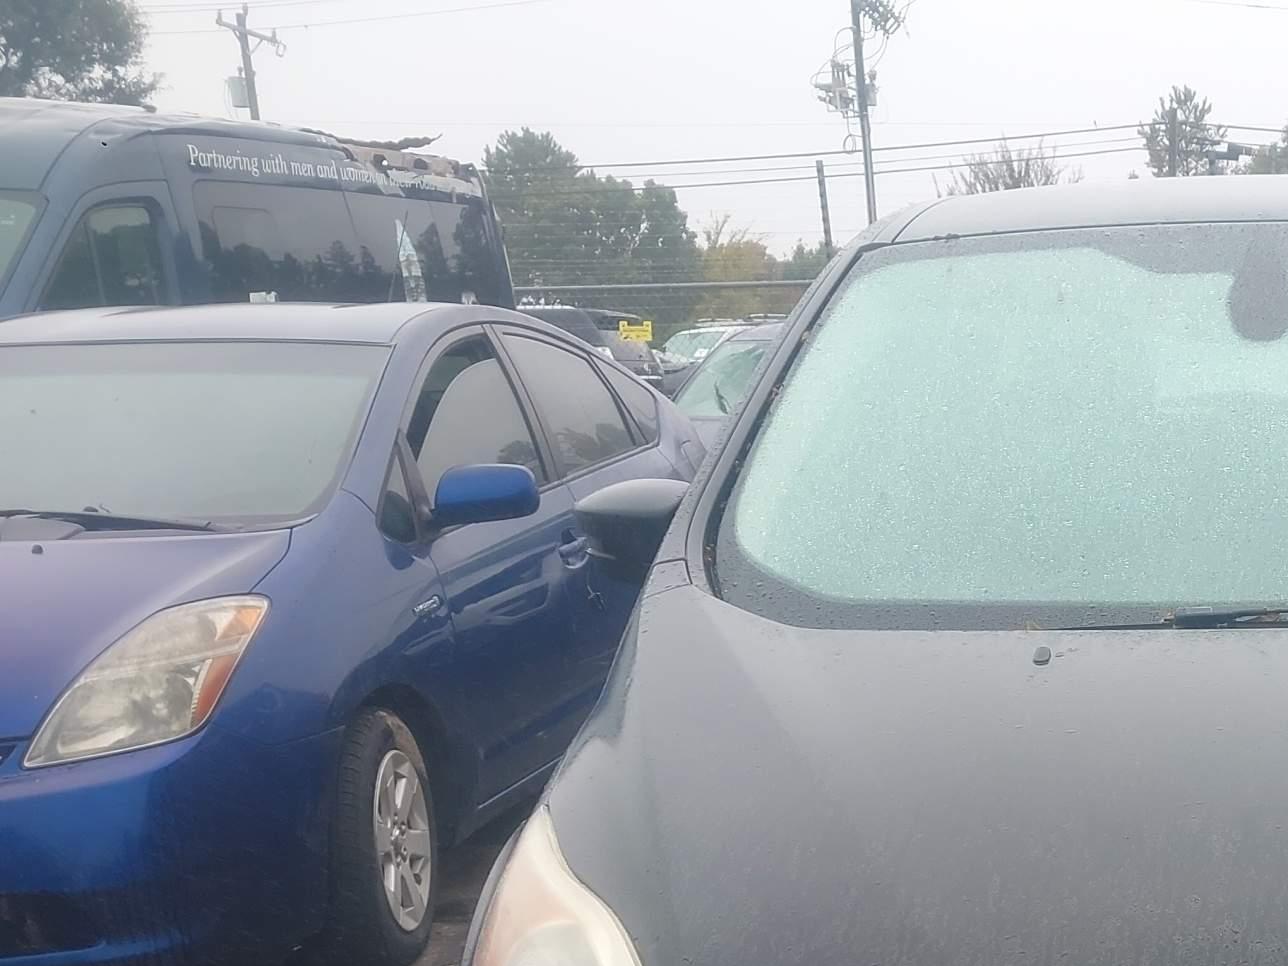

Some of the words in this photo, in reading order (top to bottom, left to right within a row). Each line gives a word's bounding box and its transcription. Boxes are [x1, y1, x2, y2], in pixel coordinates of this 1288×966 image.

[187, 144, 259, 177] Partnering
[262, 154, 288, 175] with
[290, 161, 315, 177] men
[317, 160, 338, 180] and
